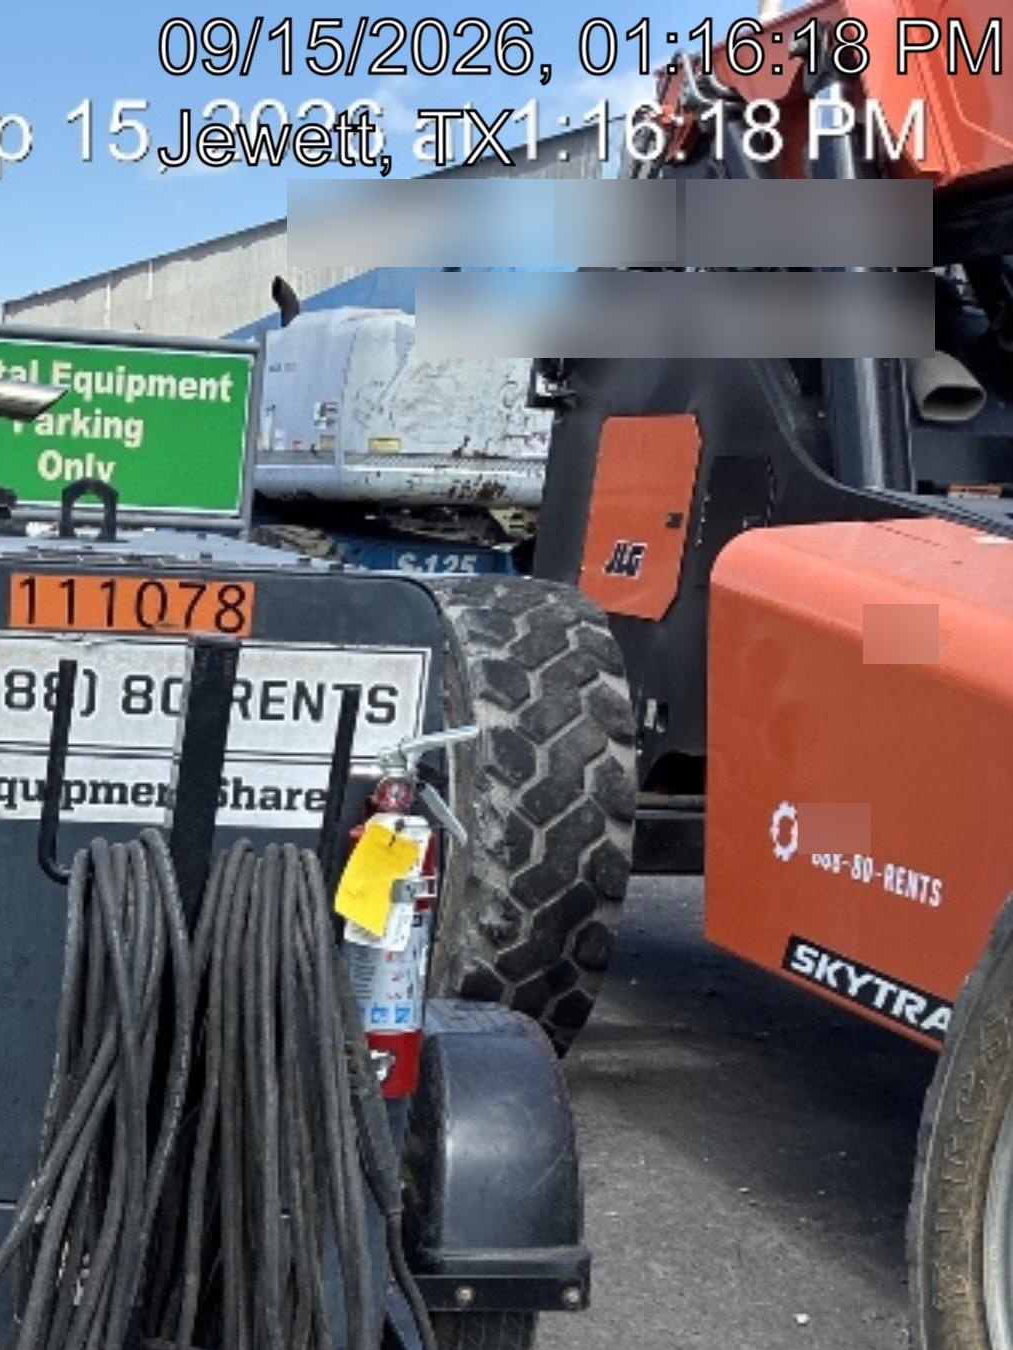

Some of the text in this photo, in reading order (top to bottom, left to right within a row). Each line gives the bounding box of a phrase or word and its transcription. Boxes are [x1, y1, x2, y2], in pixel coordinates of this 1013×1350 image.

[50, 360, 234, 403] Equipment
[13, 407, 145, 449] arking
[38, 449, 117, 484] Only
[19, 576, 246, 634] 111078
